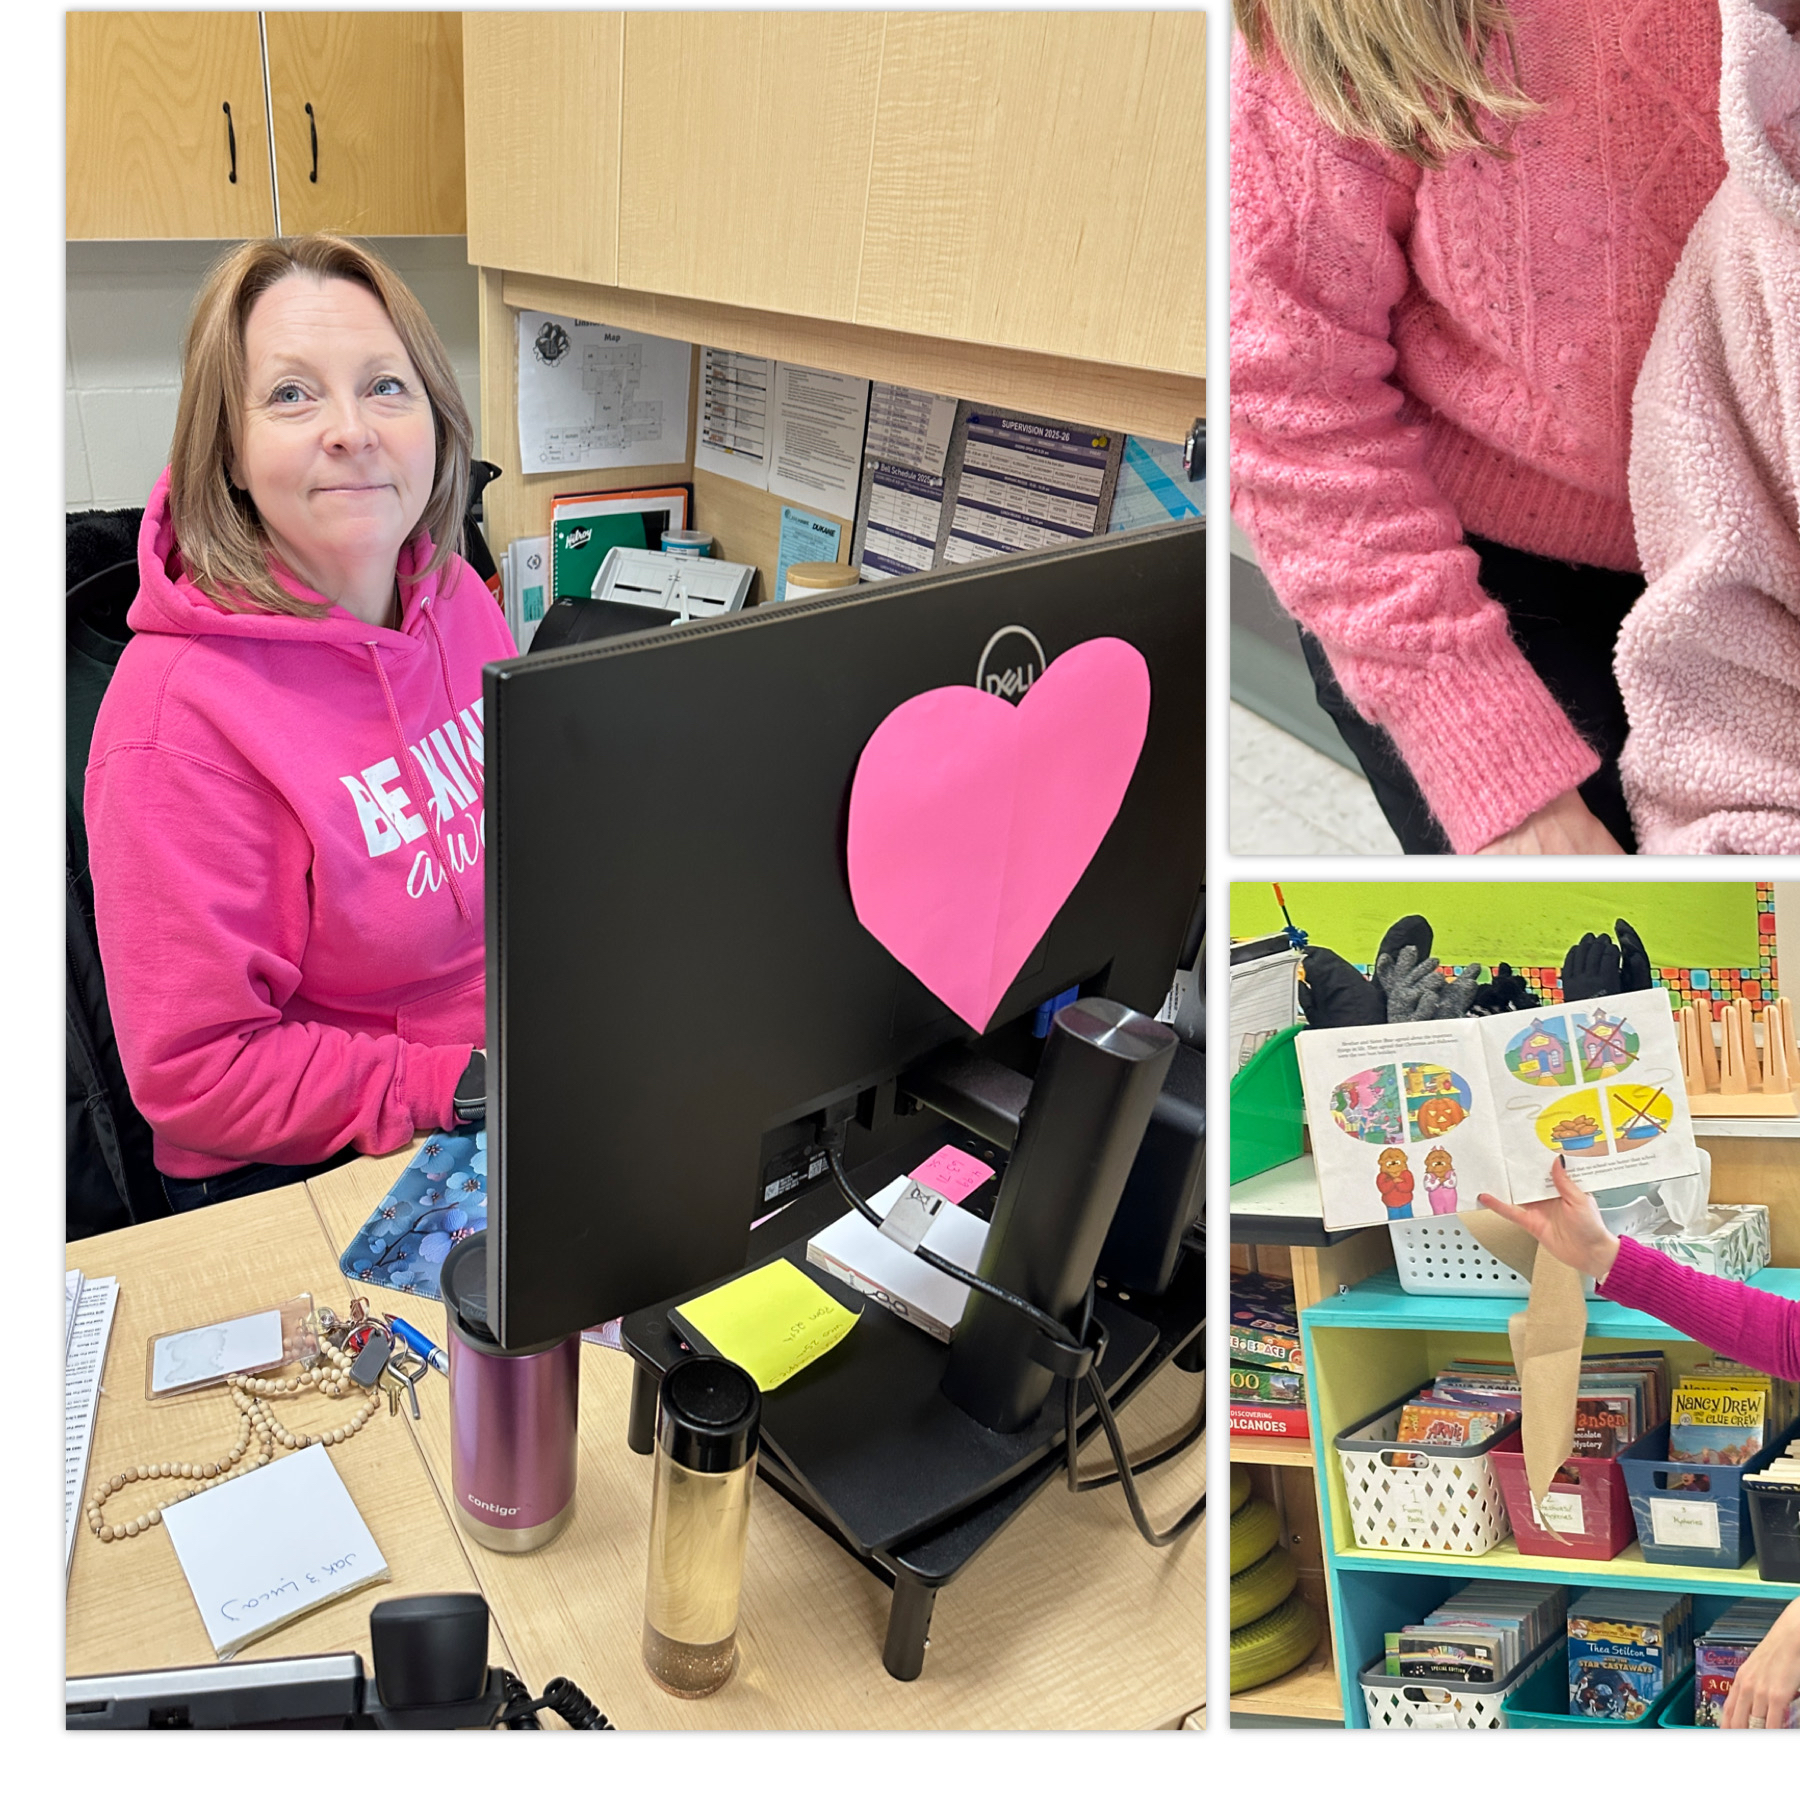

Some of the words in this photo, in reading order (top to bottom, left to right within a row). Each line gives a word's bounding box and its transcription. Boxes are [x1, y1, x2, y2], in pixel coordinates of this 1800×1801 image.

[604, 333, 620, 342] Map
[1002, 420, 1043, 436] SUPERVISION
[1045, 428, 1070, 441] 2025-26
[892, 467, 917, 480] Schedule
[565, 528, 592, 549] Hilroy
[339, 756, 428, 857] BE
[409, 697, 484, 822] KIN
[407, 797, 485, 898] alw
[1248, 1340, 1285, 1358] ESPACE
[1723, 1393, 1762, 1416] DREW
[1230, 1419, 1287, 1432] OLCANOES
[1576, 1412, 1627, 1429] ansen
[1706, 1414, 1728, 1425] CLUE
[1730, 1414, 1758, 1425] CREW
[468, 1492, 516, 1516] contigo
[1587, 1642, 1610, 1655] Thea
[1612, 1644, 1645, 1657] Stilton
[1430, 1665, 1447, 1673] SPECIAL
[1448, 1666, 1466, 1674] EDITION
[1579, 1660, 1599, 1668] STAR
[1602, 1661, 1654, 1674] CASTAWAYS
[1708, 1679, 1717, 1689] A
